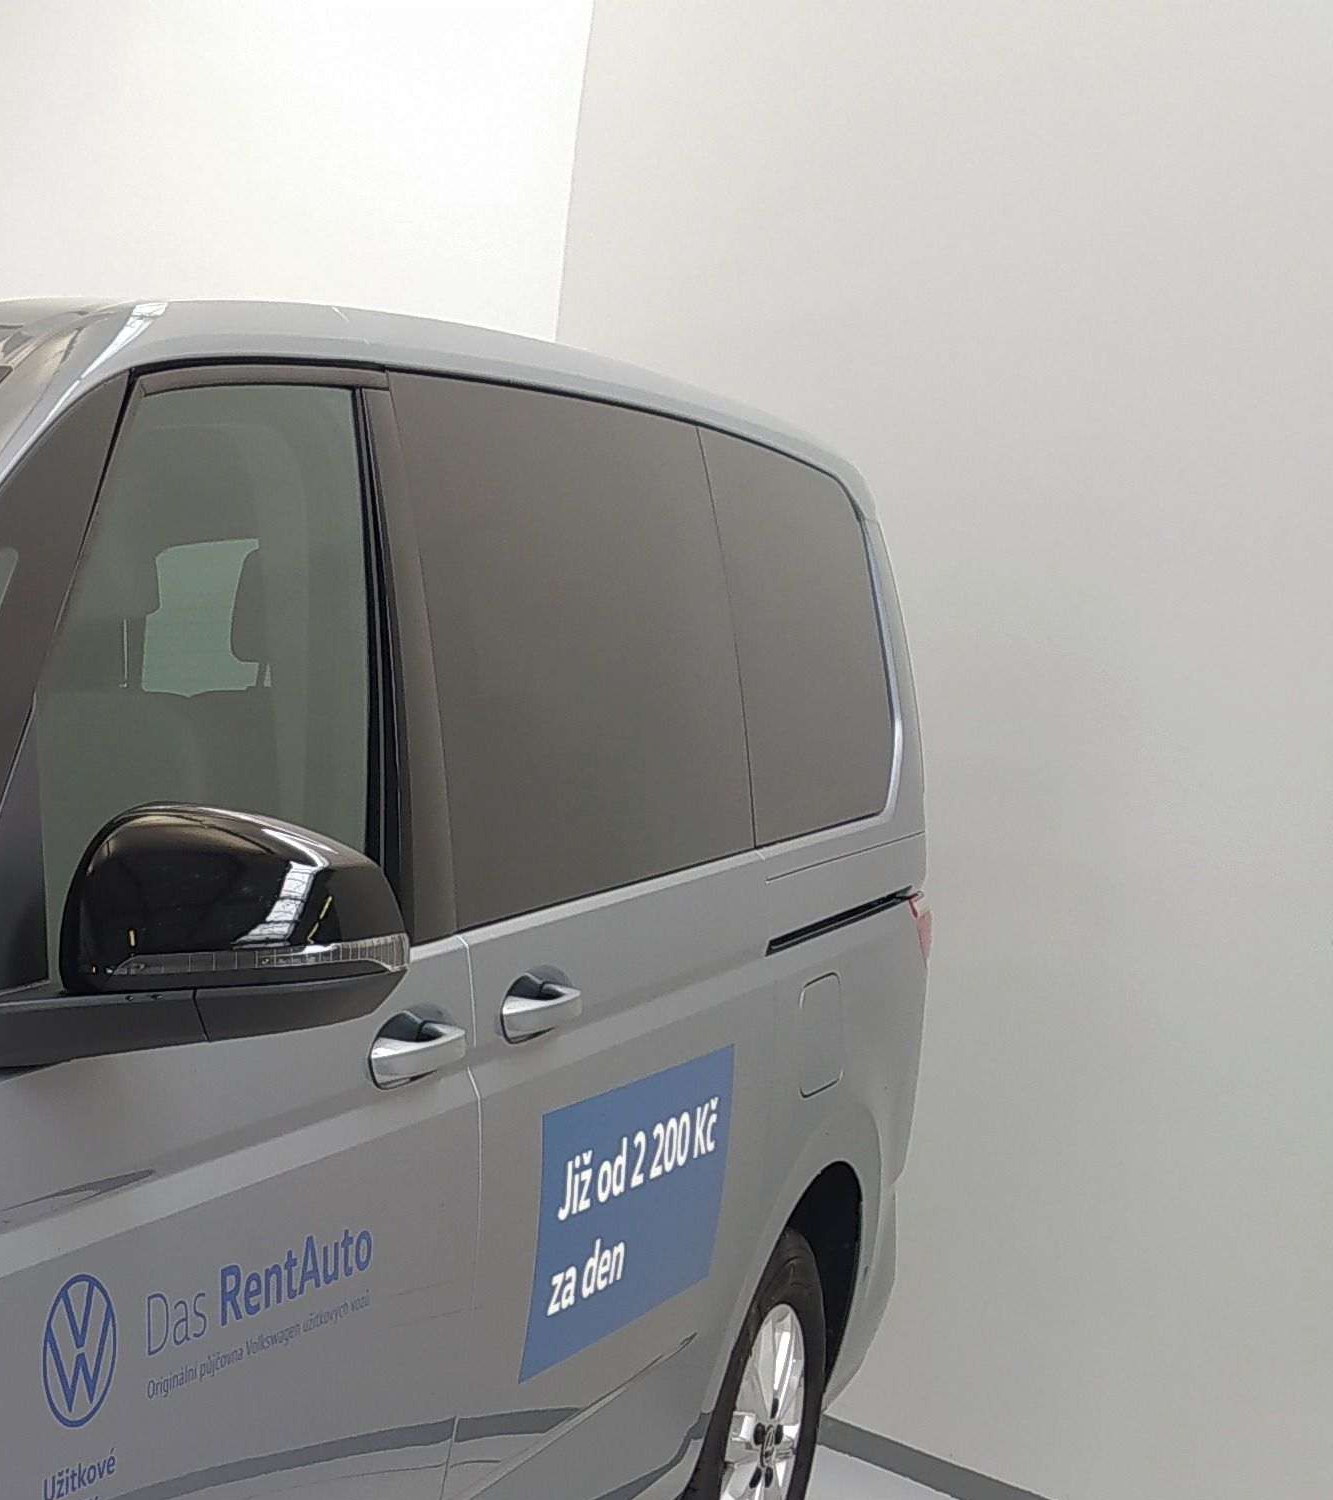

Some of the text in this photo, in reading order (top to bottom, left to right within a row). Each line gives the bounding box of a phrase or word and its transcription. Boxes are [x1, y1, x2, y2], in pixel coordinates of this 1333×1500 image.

[558, 1097, 719, 1221] Již od 2 200 Kč
[147, 1228, 373, 1356] Das RentAuto
[546, 1238, 626, 1316] za den
[245, 1321, 301, 1357] Volkswagen
